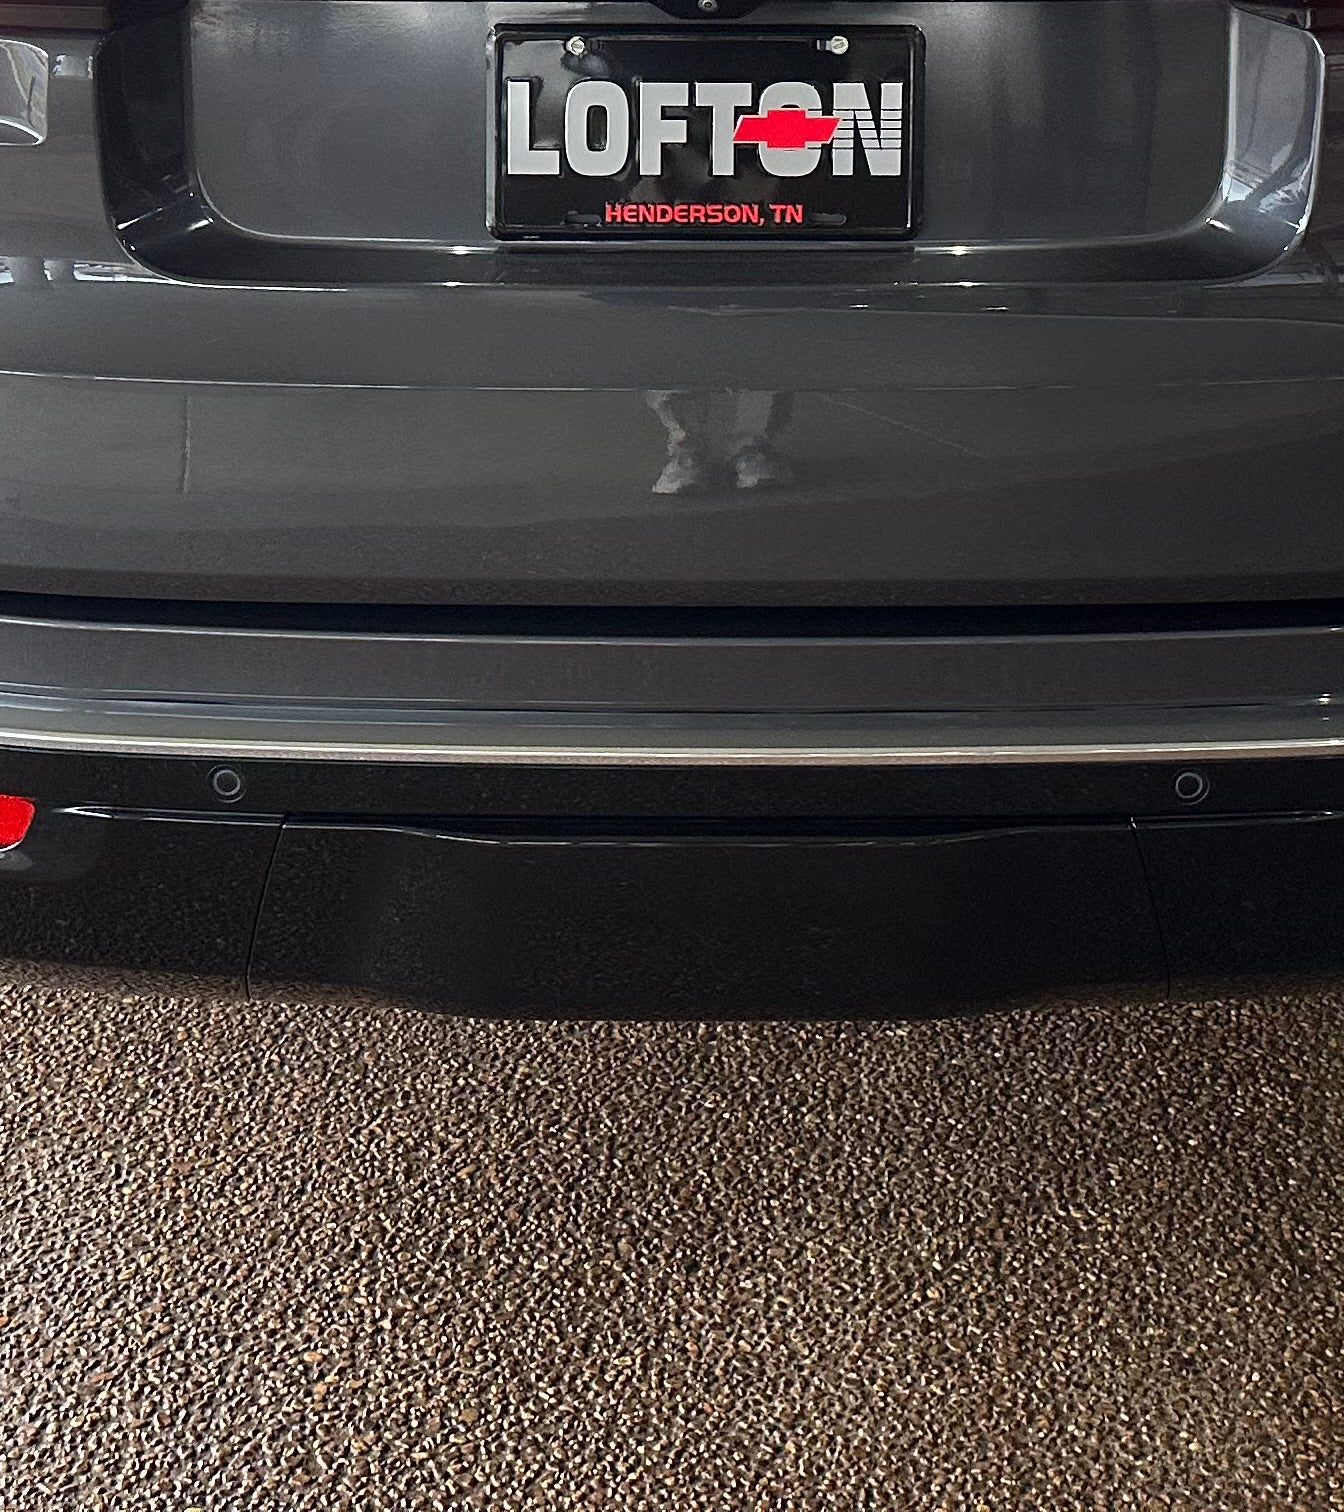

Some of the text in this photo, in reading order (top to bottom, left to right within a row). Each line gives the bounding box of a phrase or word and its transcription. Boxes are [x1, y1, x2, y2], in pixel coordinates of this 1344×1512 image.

[507, 80, 903, 177] LOFTON
[605, 201, 804, 227] HENDERSON, TN
